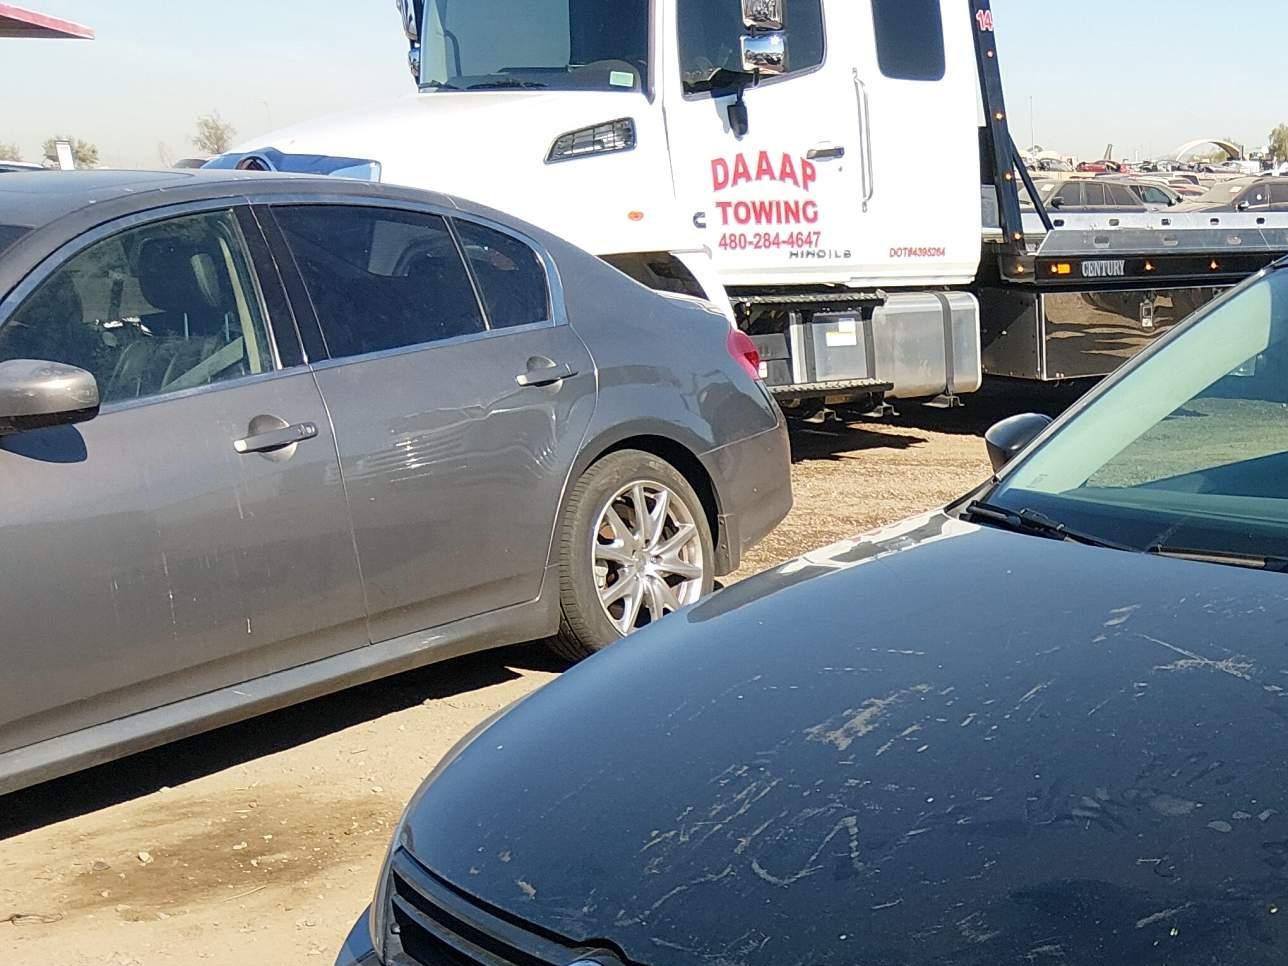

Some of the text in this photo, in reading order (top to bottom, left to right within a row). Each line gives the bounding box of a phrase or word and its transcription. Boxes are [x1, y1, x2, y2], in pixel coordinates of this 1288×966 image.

[711, 150, 817, 193] DAAAP
[715, 200, 819, 226] TOWING
[718, 231, 821, 251] 480-284-4647
[1081, 259, 1126, 277] CENTURY
